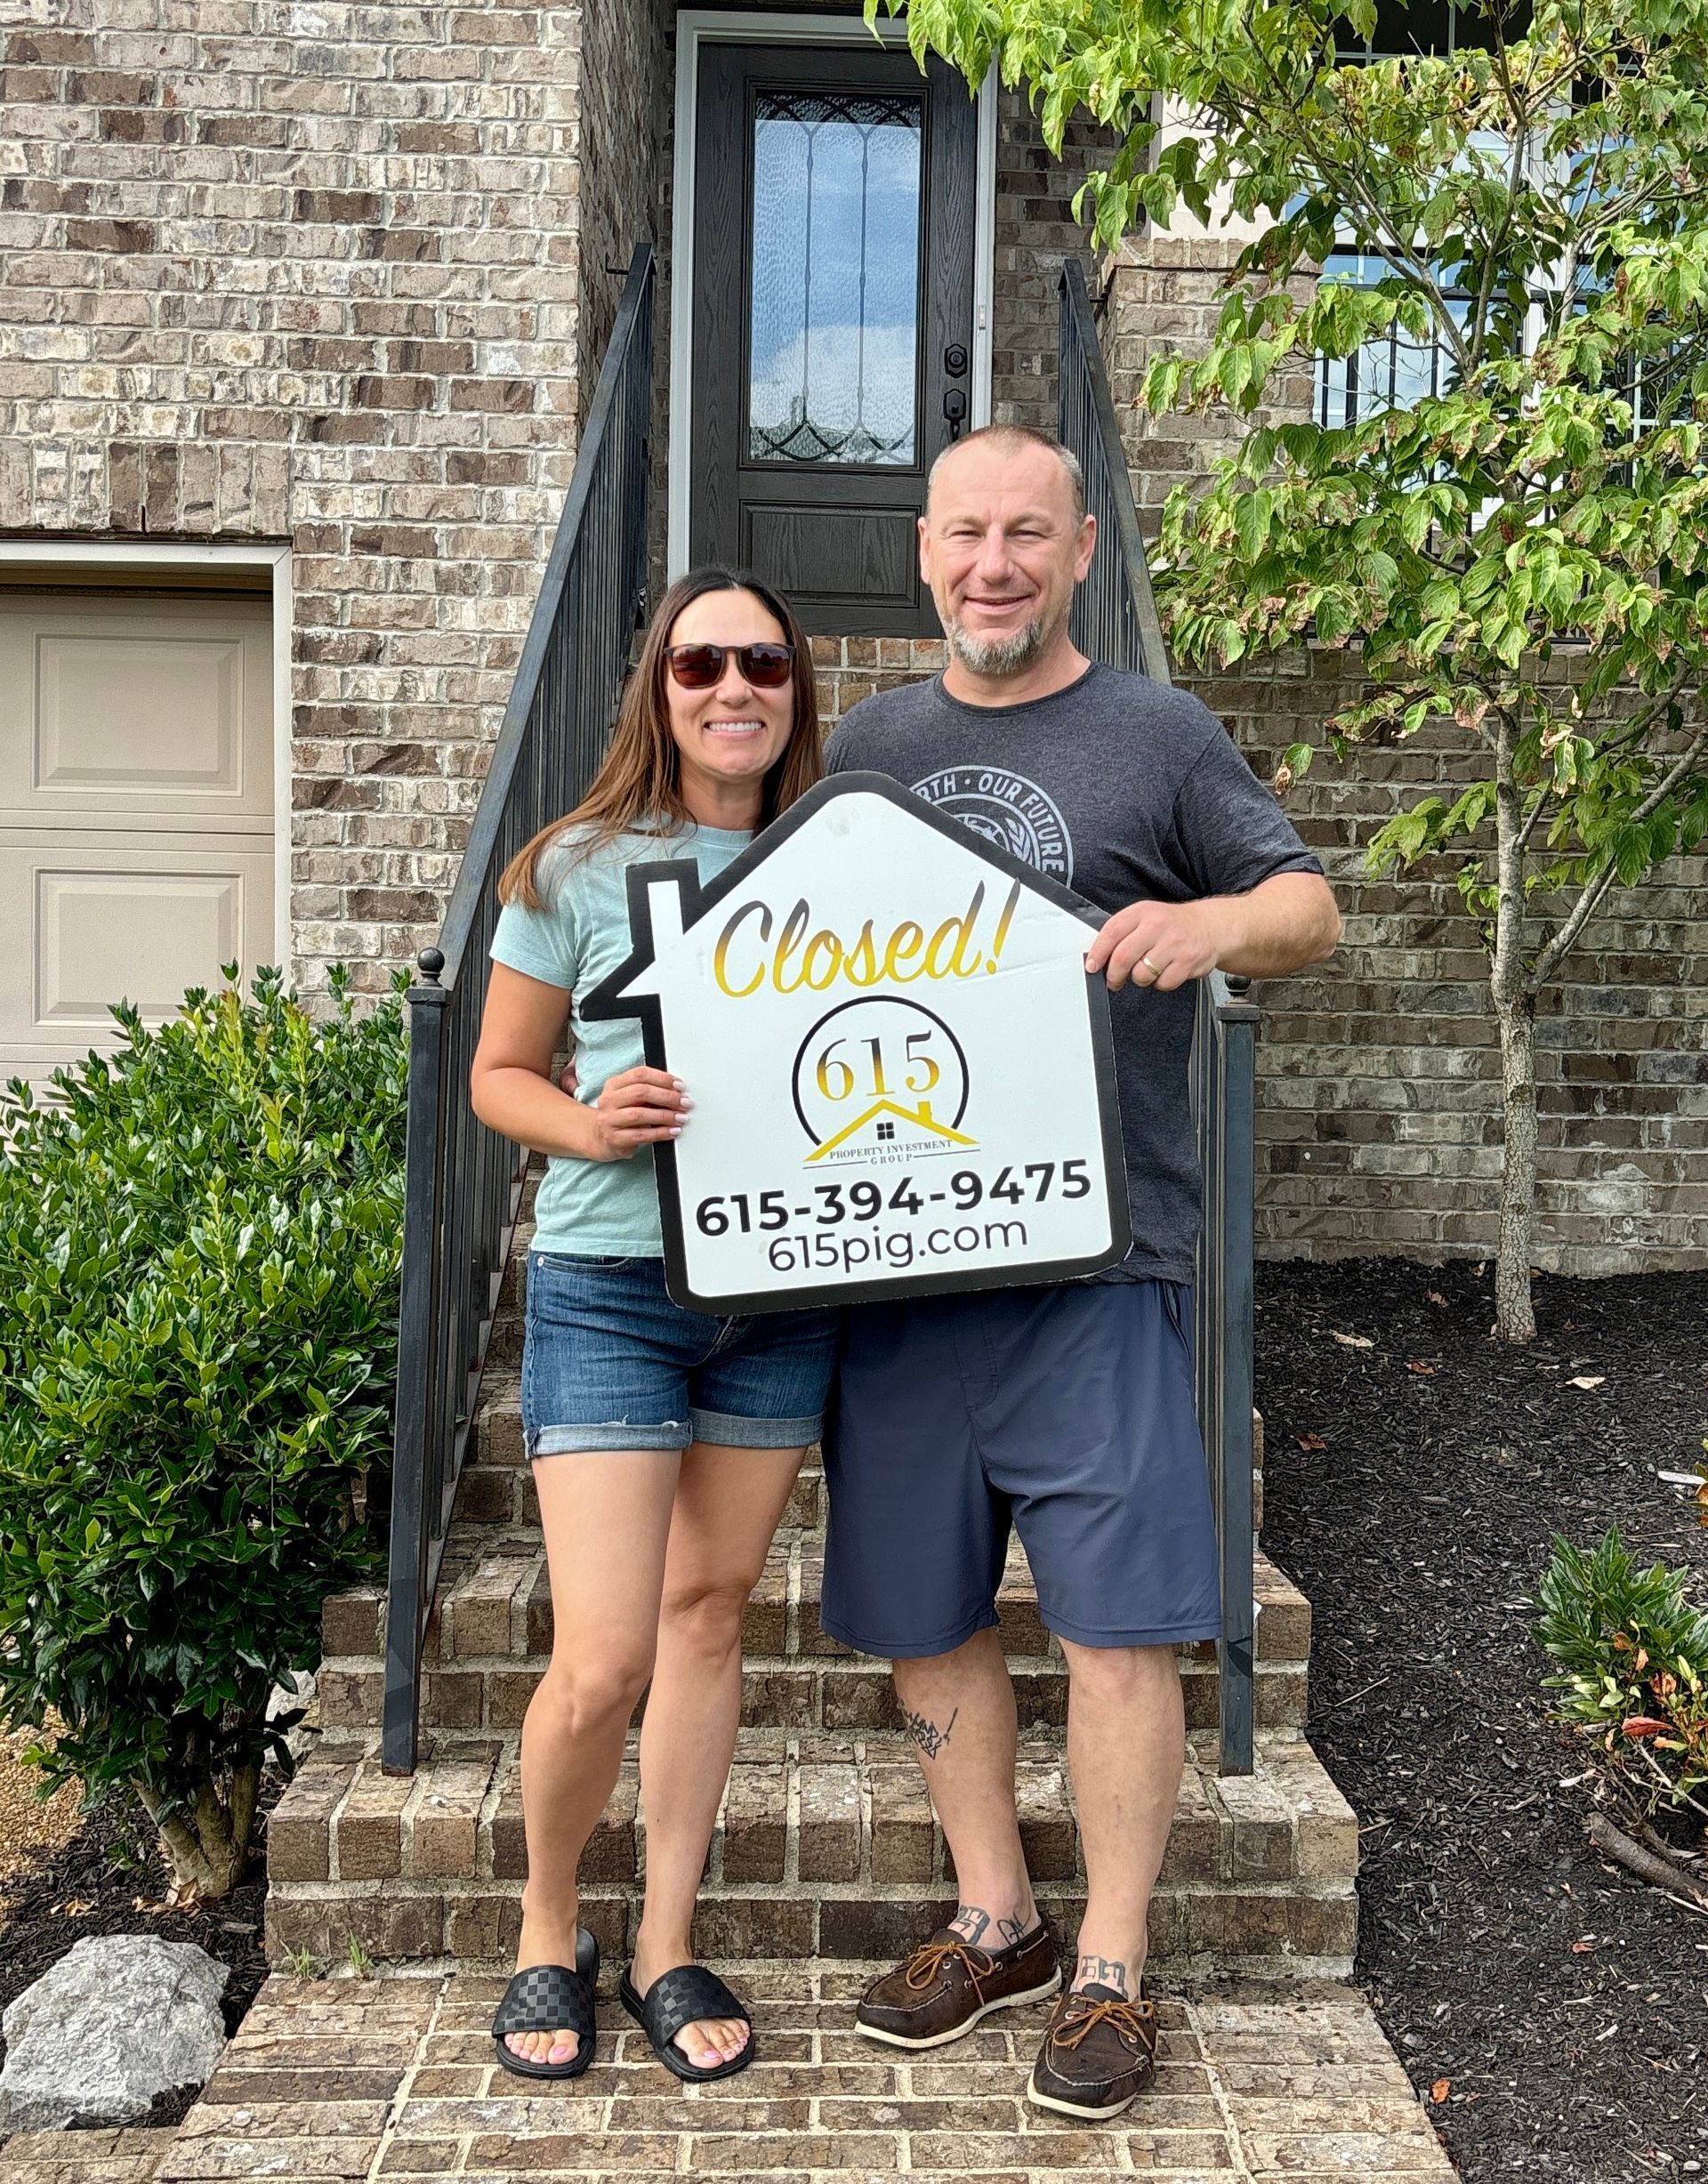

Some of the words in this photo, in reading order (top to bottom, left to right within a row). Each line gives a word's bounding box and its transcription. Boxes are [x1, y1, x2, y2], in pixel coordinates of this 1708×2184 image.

[915, 774, 956, 803] RTH
[978, 773, 1022, 802] OUR
[1019, 794, 1065, 872] FUTURE
[713, 876, 1020, 997] Closed!
[816, 1030, 940, 1101] 615
[829, 1147, 884, 1160] PROPERTY
[887, 1140, 953, 1154] INVESTMENT
[870, 1154, 912, 1165] GROUP
[696, 1159, 1092, 1236] 615-394-9475
[768, 1220, 1027, 1273] 615pig.com
